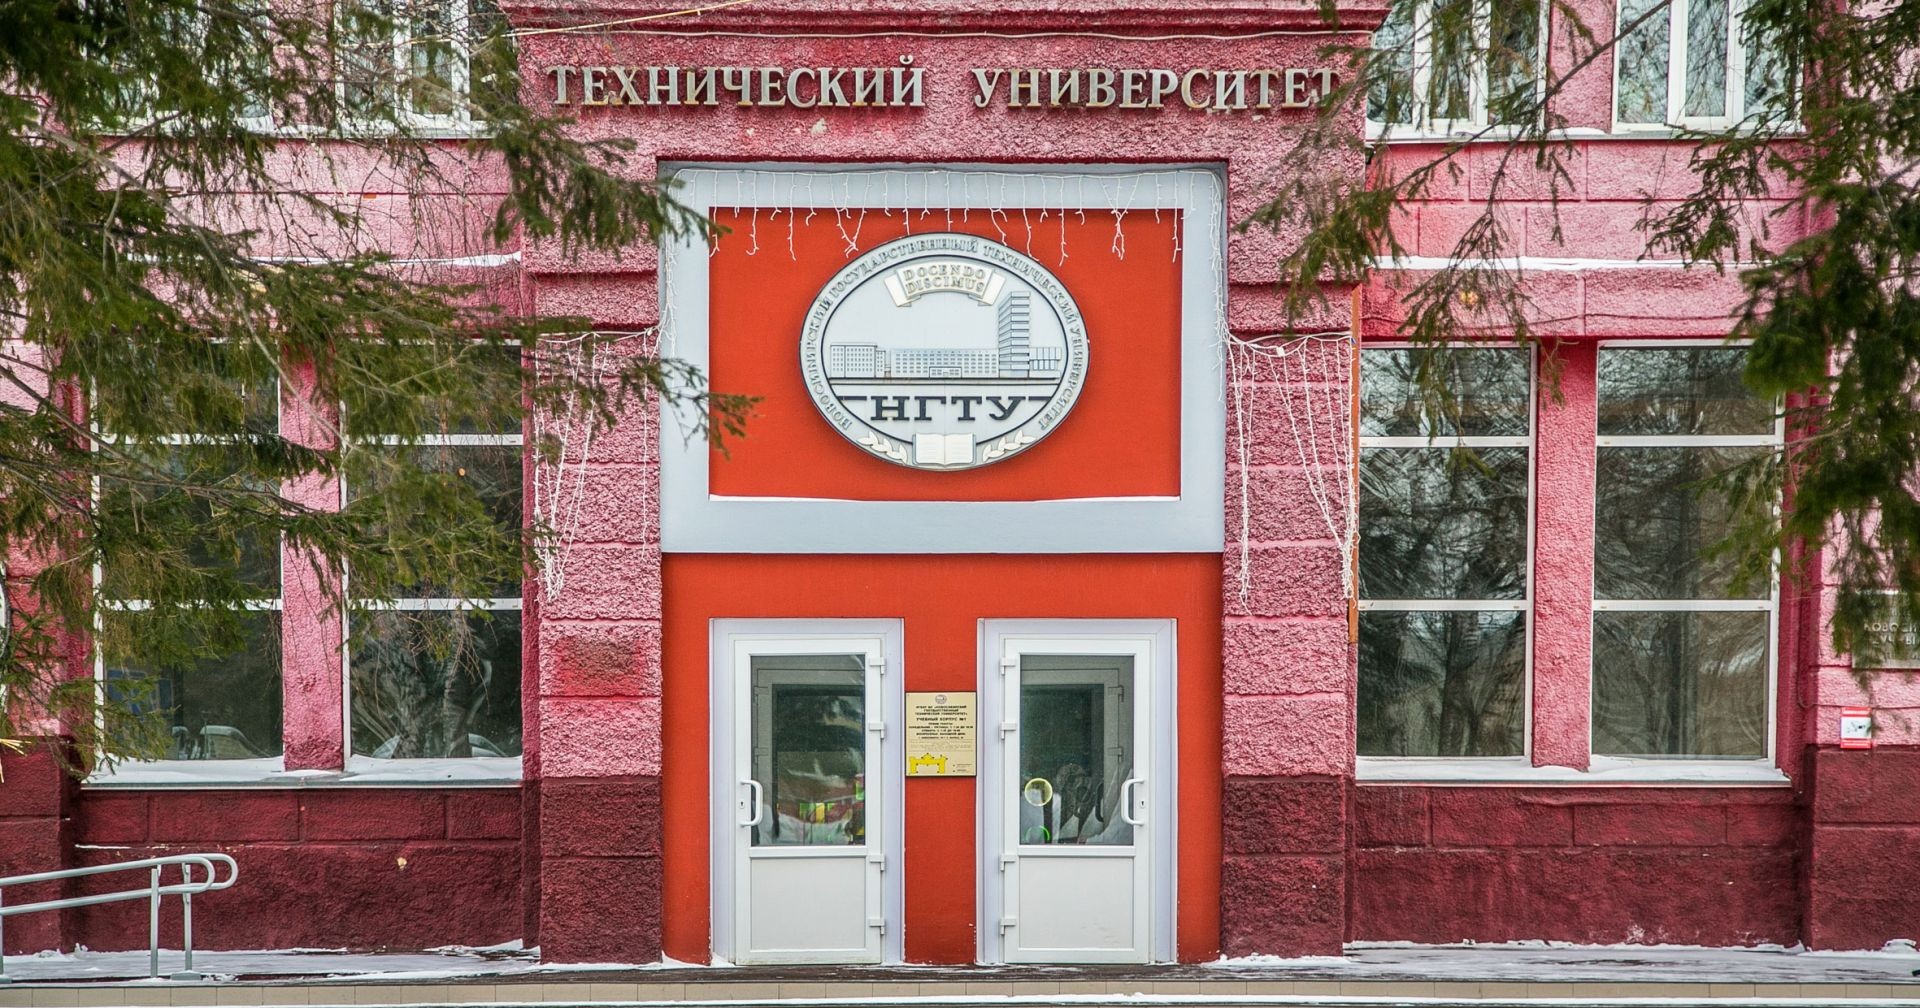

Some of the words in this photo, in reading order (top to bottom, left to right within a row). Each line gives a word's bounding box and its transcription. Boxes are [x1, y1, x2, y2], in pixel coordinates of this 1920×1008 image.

[546, 54, 926, 107] ТЕХНИЧЕСКИЙ
[971, 68, 1340, 109] УНИВЕРСИТЕТ
[902, 264, 986, 281] DOCENDO
[905, 276, 986, 294] DISCIMUS
[828, 238, 979, 298] ГОСУДАРСТВЕННЫЙ
[983, 245, 1080, 325] ТЕХНИЧЕСКИЙ
[1038, 323, 1084, 431] УНИВЕРСИТЕТ
[870, 395, 1026, 421] НГТУ
